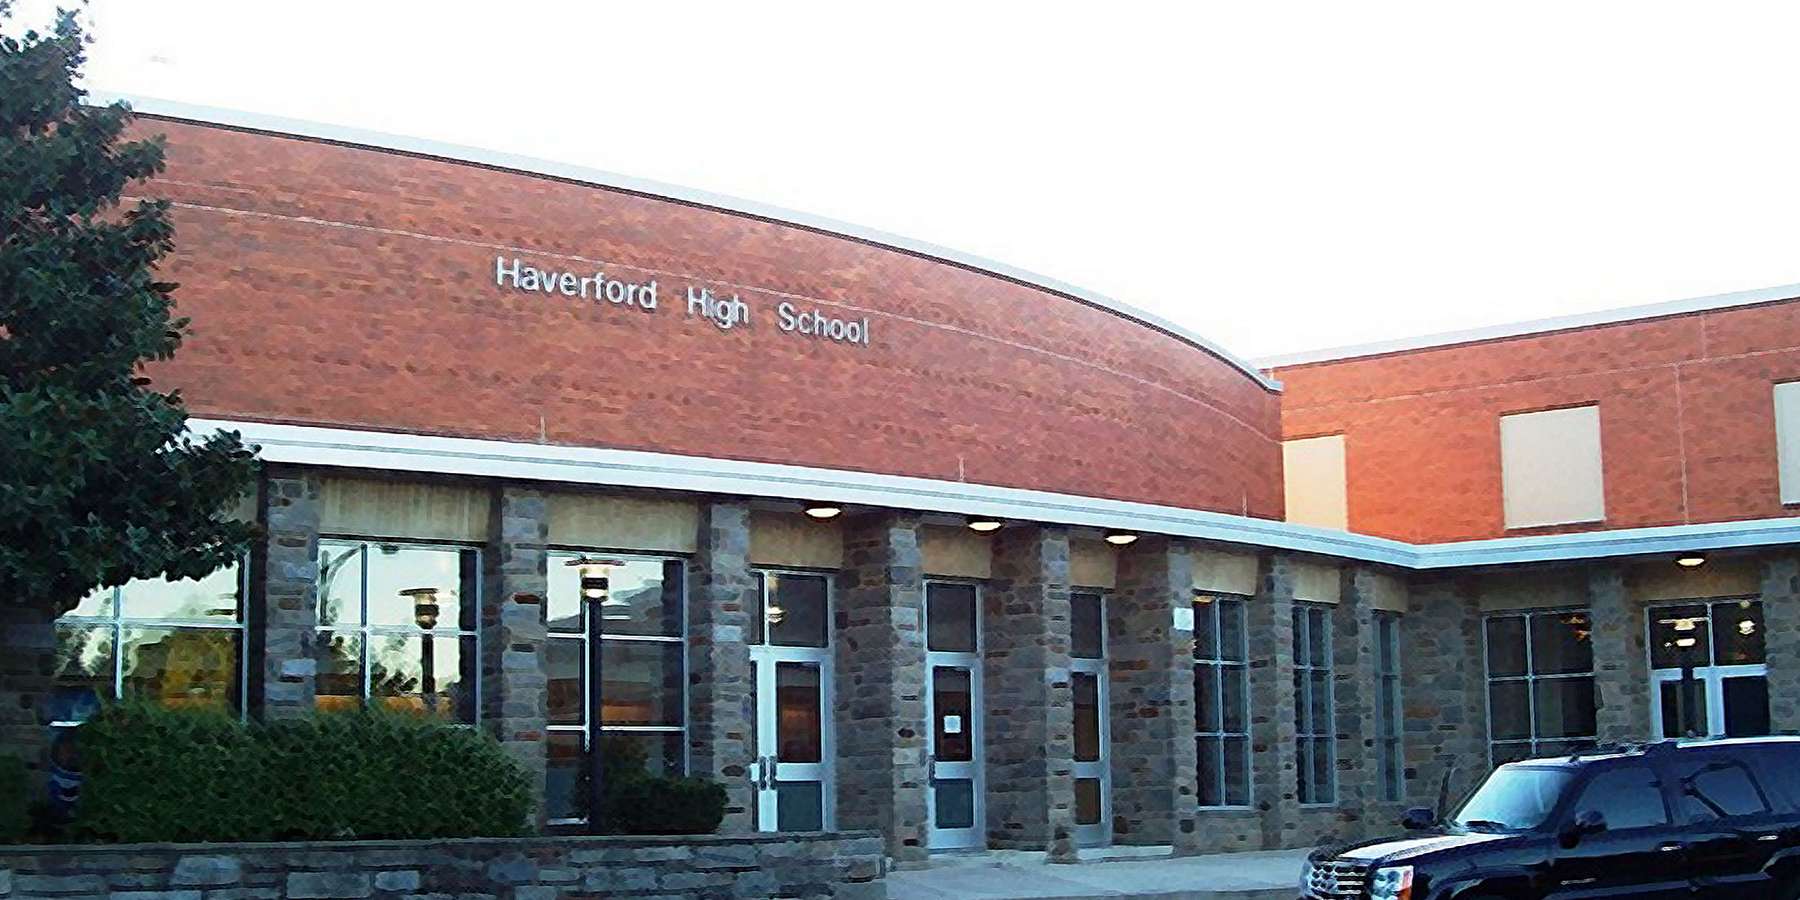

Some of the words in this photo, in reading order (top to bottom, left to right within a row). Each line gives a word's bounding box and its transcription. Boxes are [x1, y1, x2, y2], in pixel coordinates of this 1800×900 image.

[495, 256, 658, 310] Haverford
[686, 286, 750, 329] High
[777, 302, 870, 346] School
